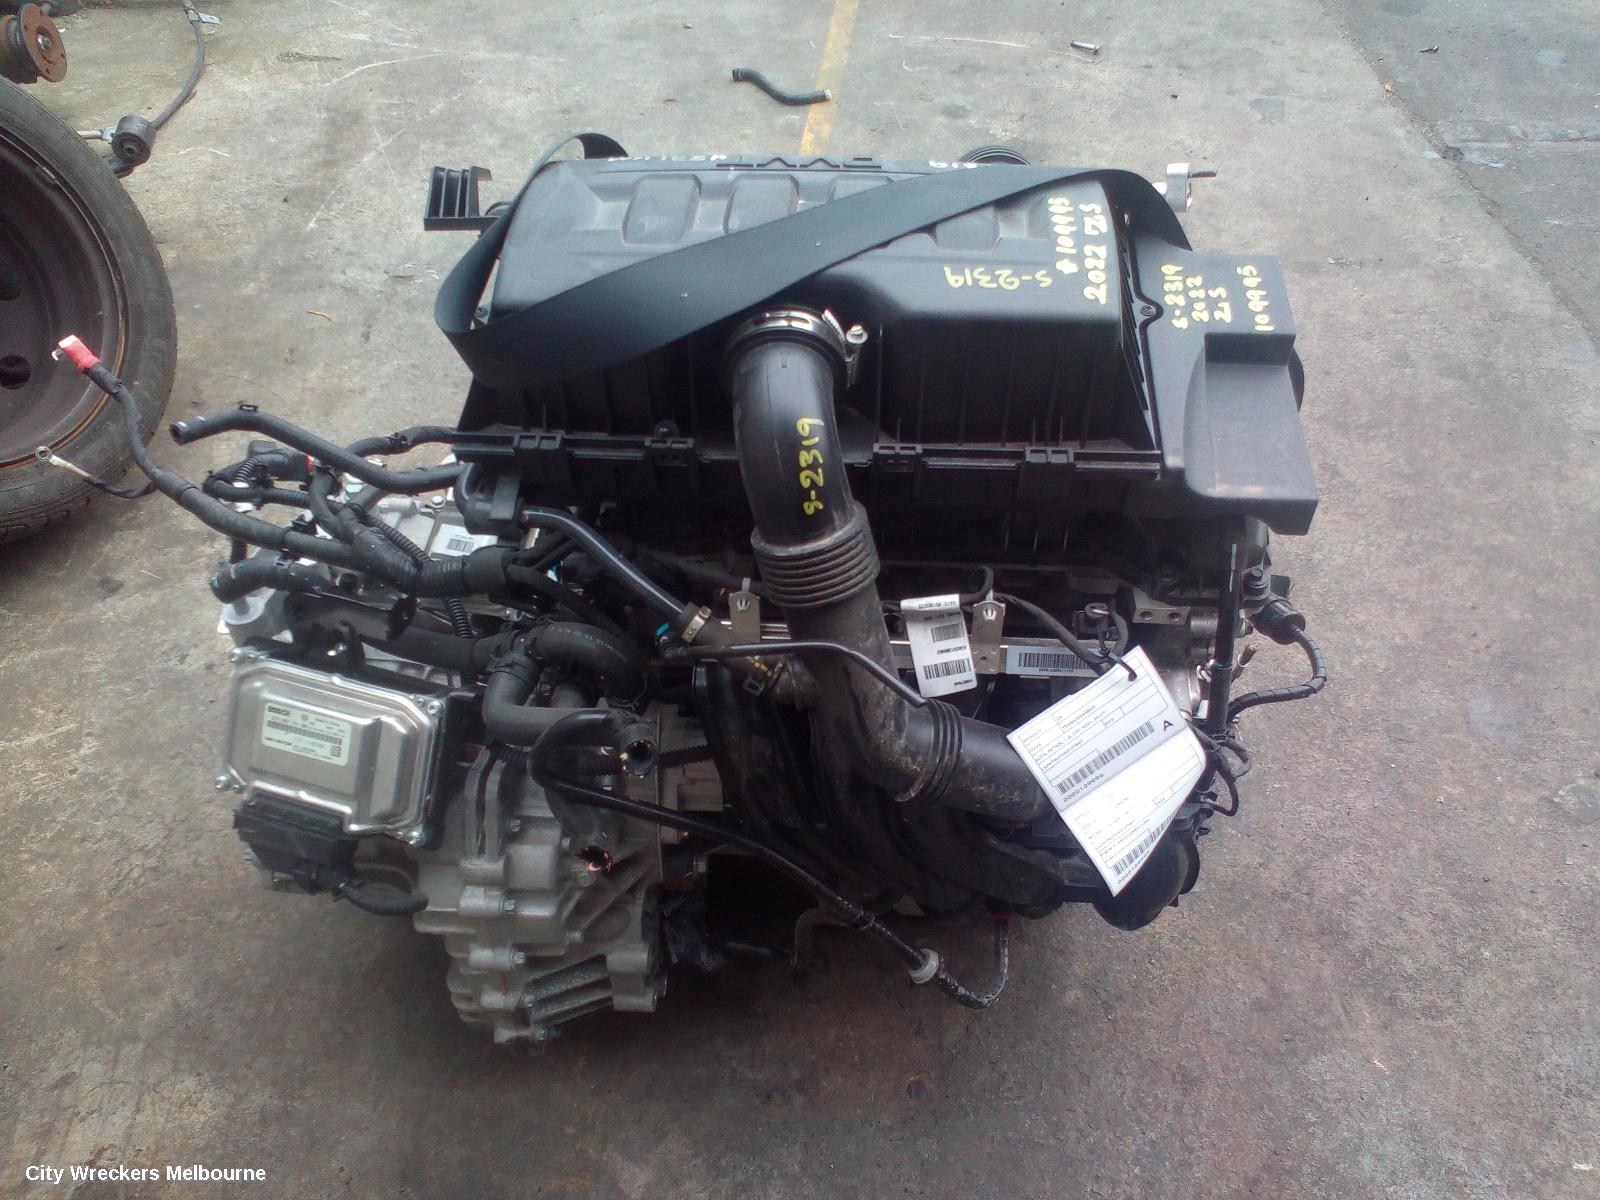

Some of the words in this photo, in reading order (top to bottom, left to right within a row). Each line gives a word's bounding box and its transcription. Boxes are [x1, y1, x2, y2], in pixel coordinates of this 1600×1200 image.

[943, 266, 1053, 291] S-2319
[1083, 244, 1108, 305] 2022
[1185, 274, 1210, 323] 2022
[795, 416, 826, 515] S-2319
[1159, 717, 1175, 732] A
